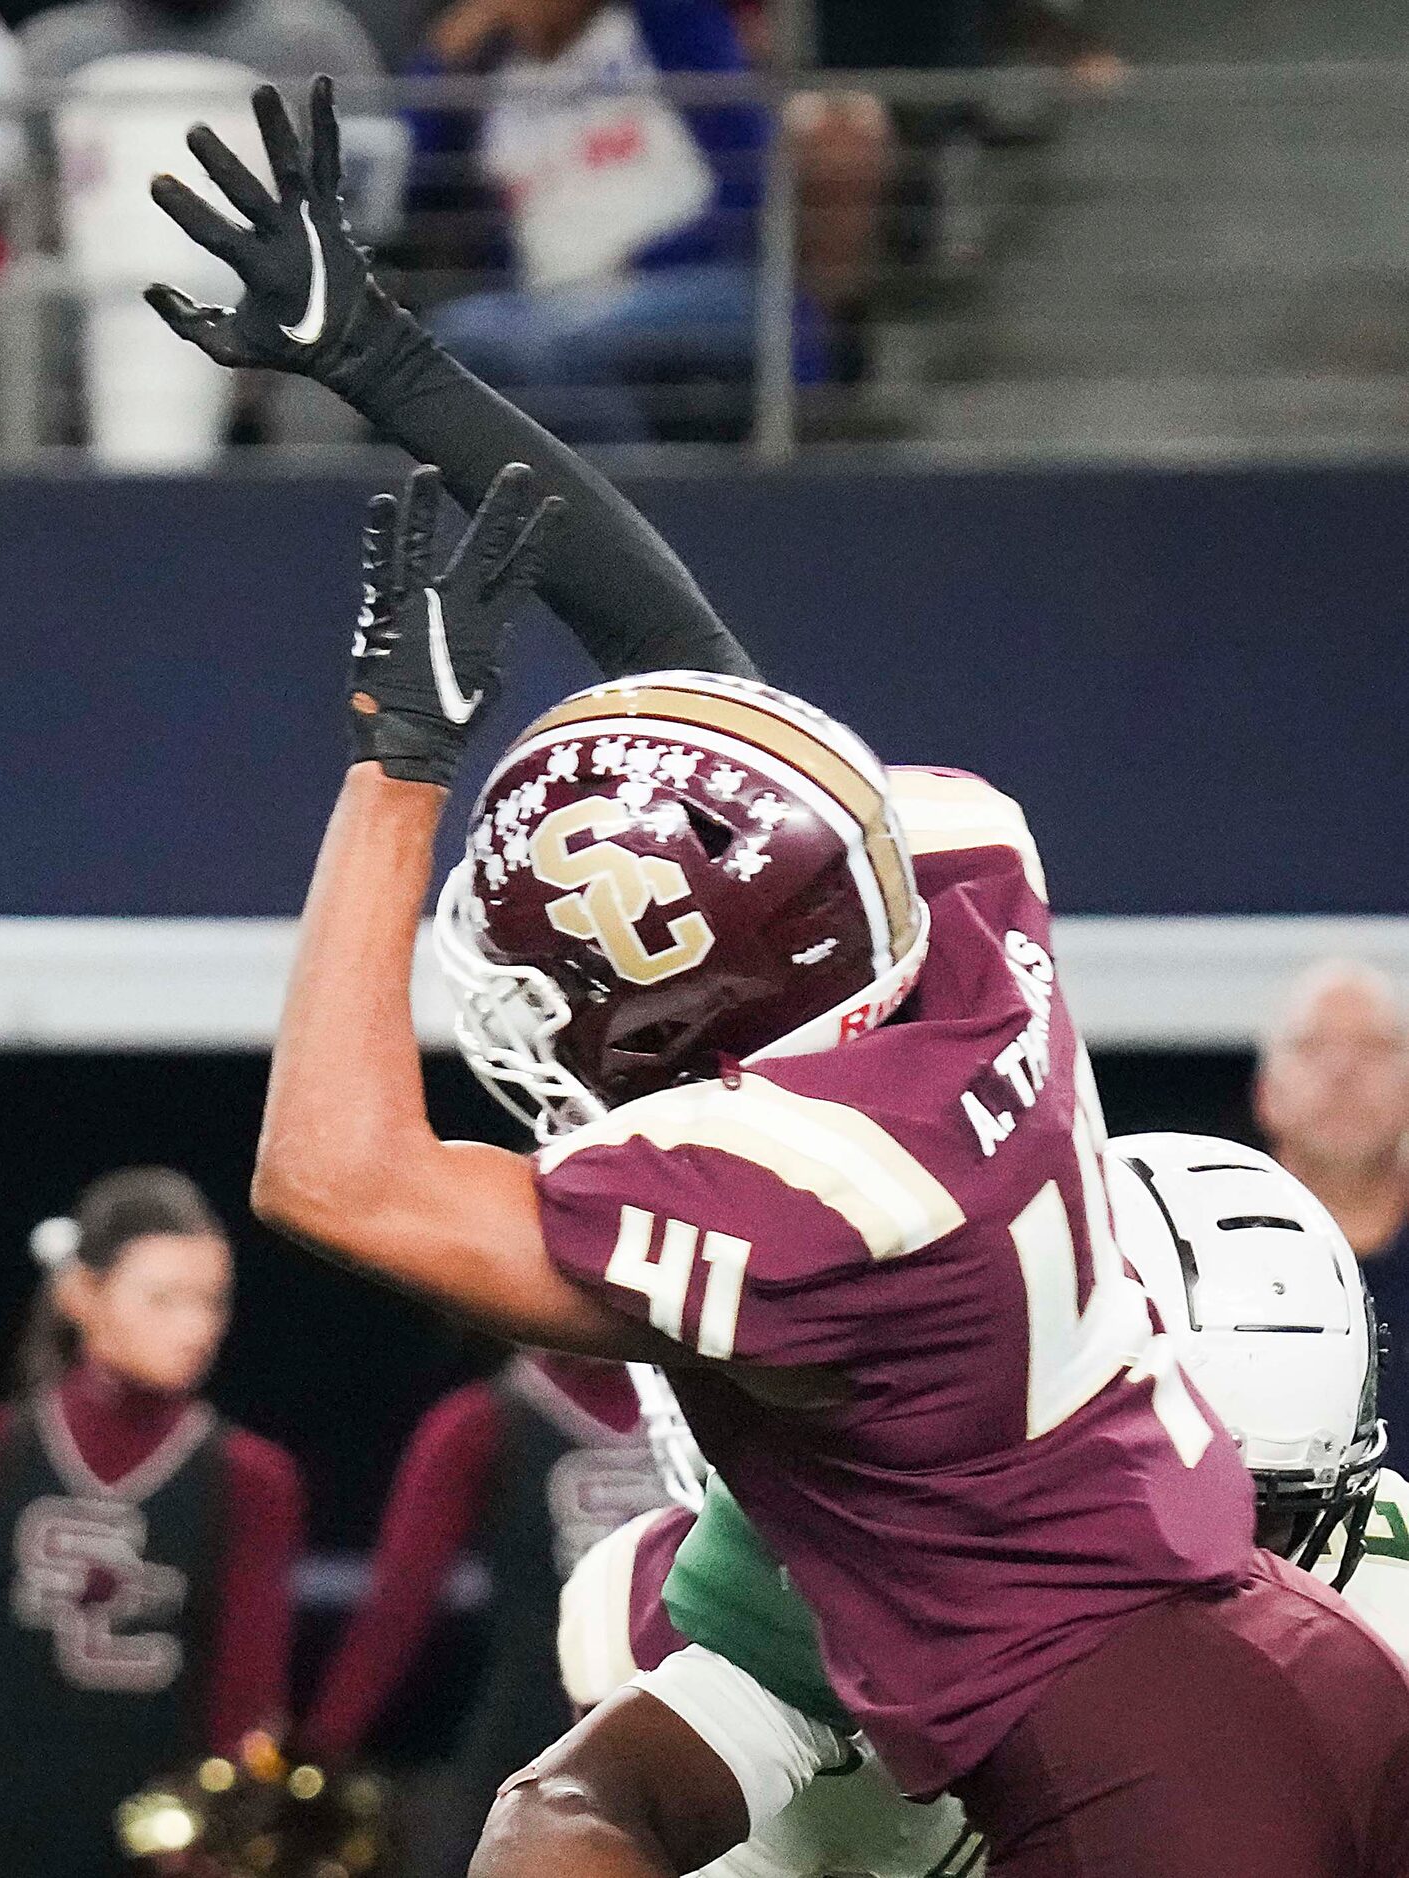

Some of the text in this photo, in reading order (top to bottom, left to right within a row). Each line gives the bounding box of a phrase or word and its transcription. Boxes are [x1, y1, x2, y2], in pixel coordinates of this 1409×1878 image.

[529, 795, 716, 986] SC
[960, 1090, 1017, 1158] A.
[604, 1204, 752, 1360] 41
[1007, 1080, 1214, 1470] 4
[10, 1496, 190, 1693] SC
